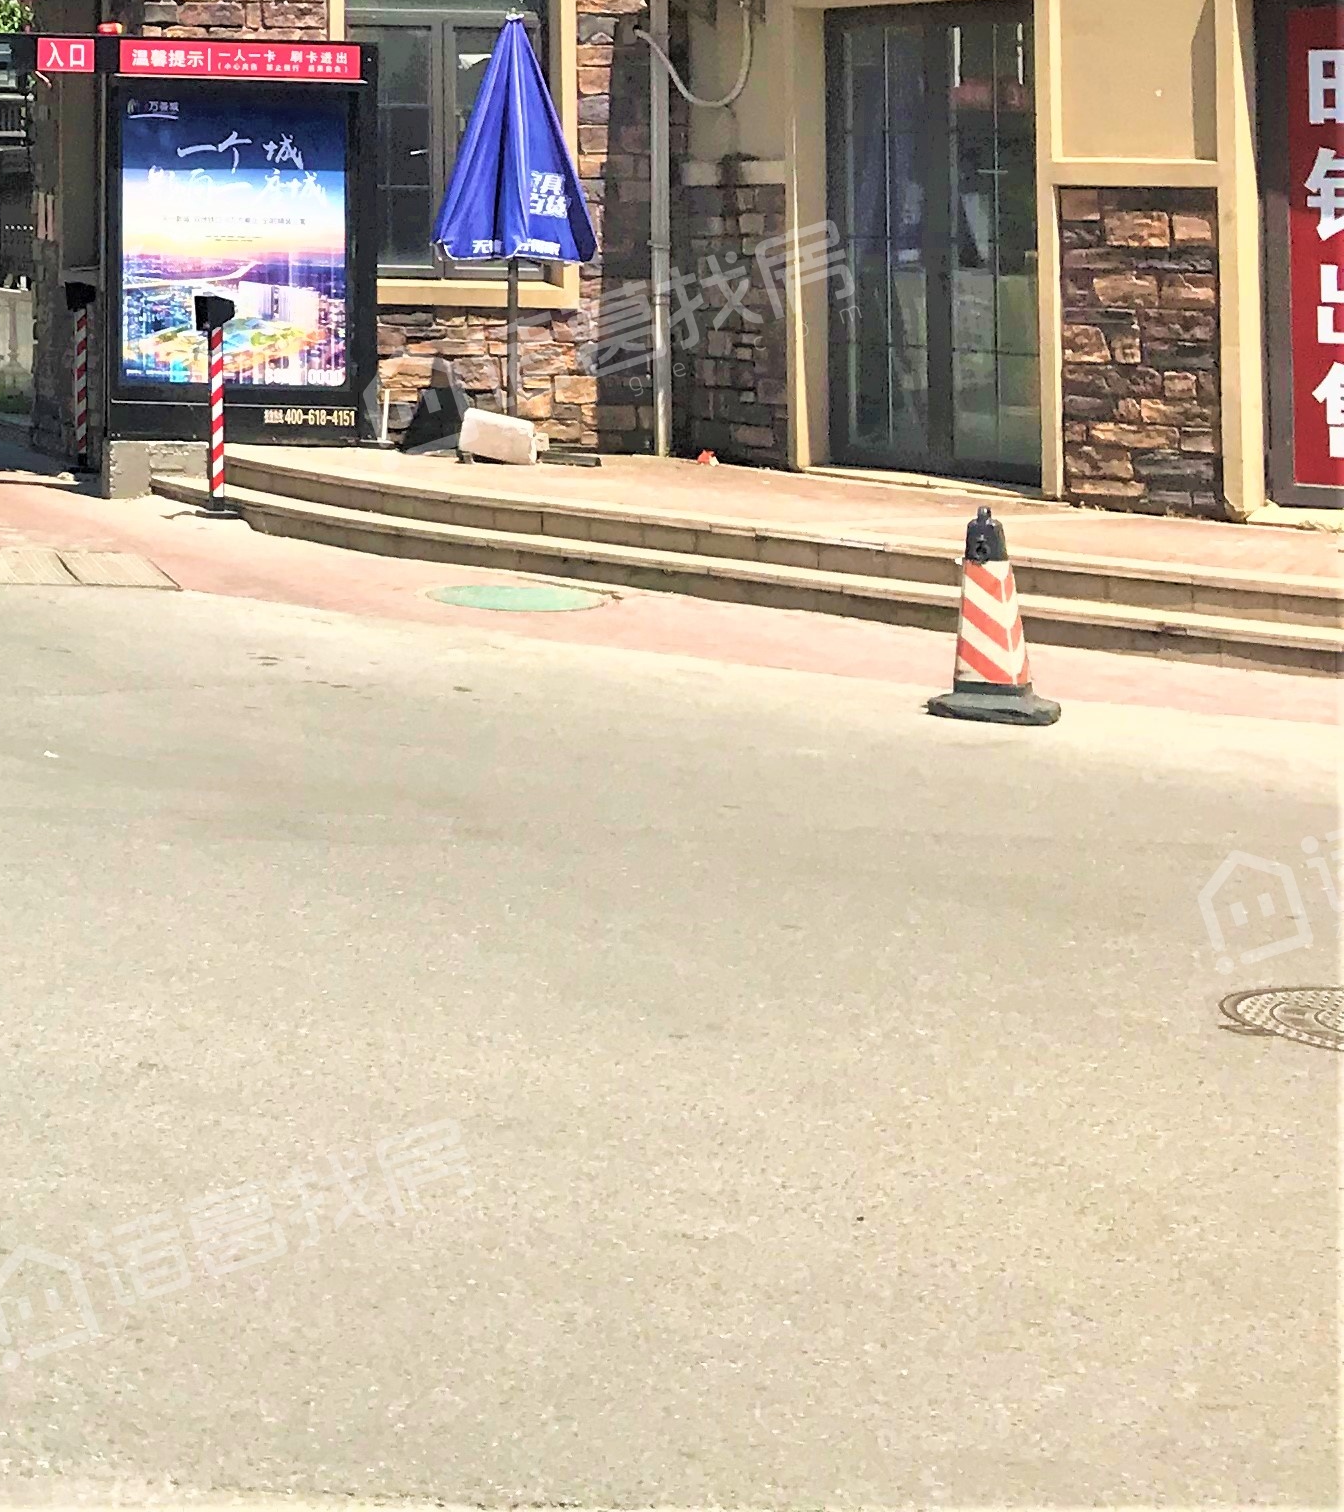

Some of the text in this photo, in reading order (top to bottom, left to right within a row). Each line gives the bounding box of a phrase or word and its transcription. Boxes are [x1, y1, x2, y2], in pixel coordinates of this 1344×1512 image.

[46, 42, 85, 67] 入口
[132, 48, 204, 67] 温馨提示
[218, 48, 348, 65] 一人一卡 刷卡进出
[284, 409, 355, 427] 400-618-4151
